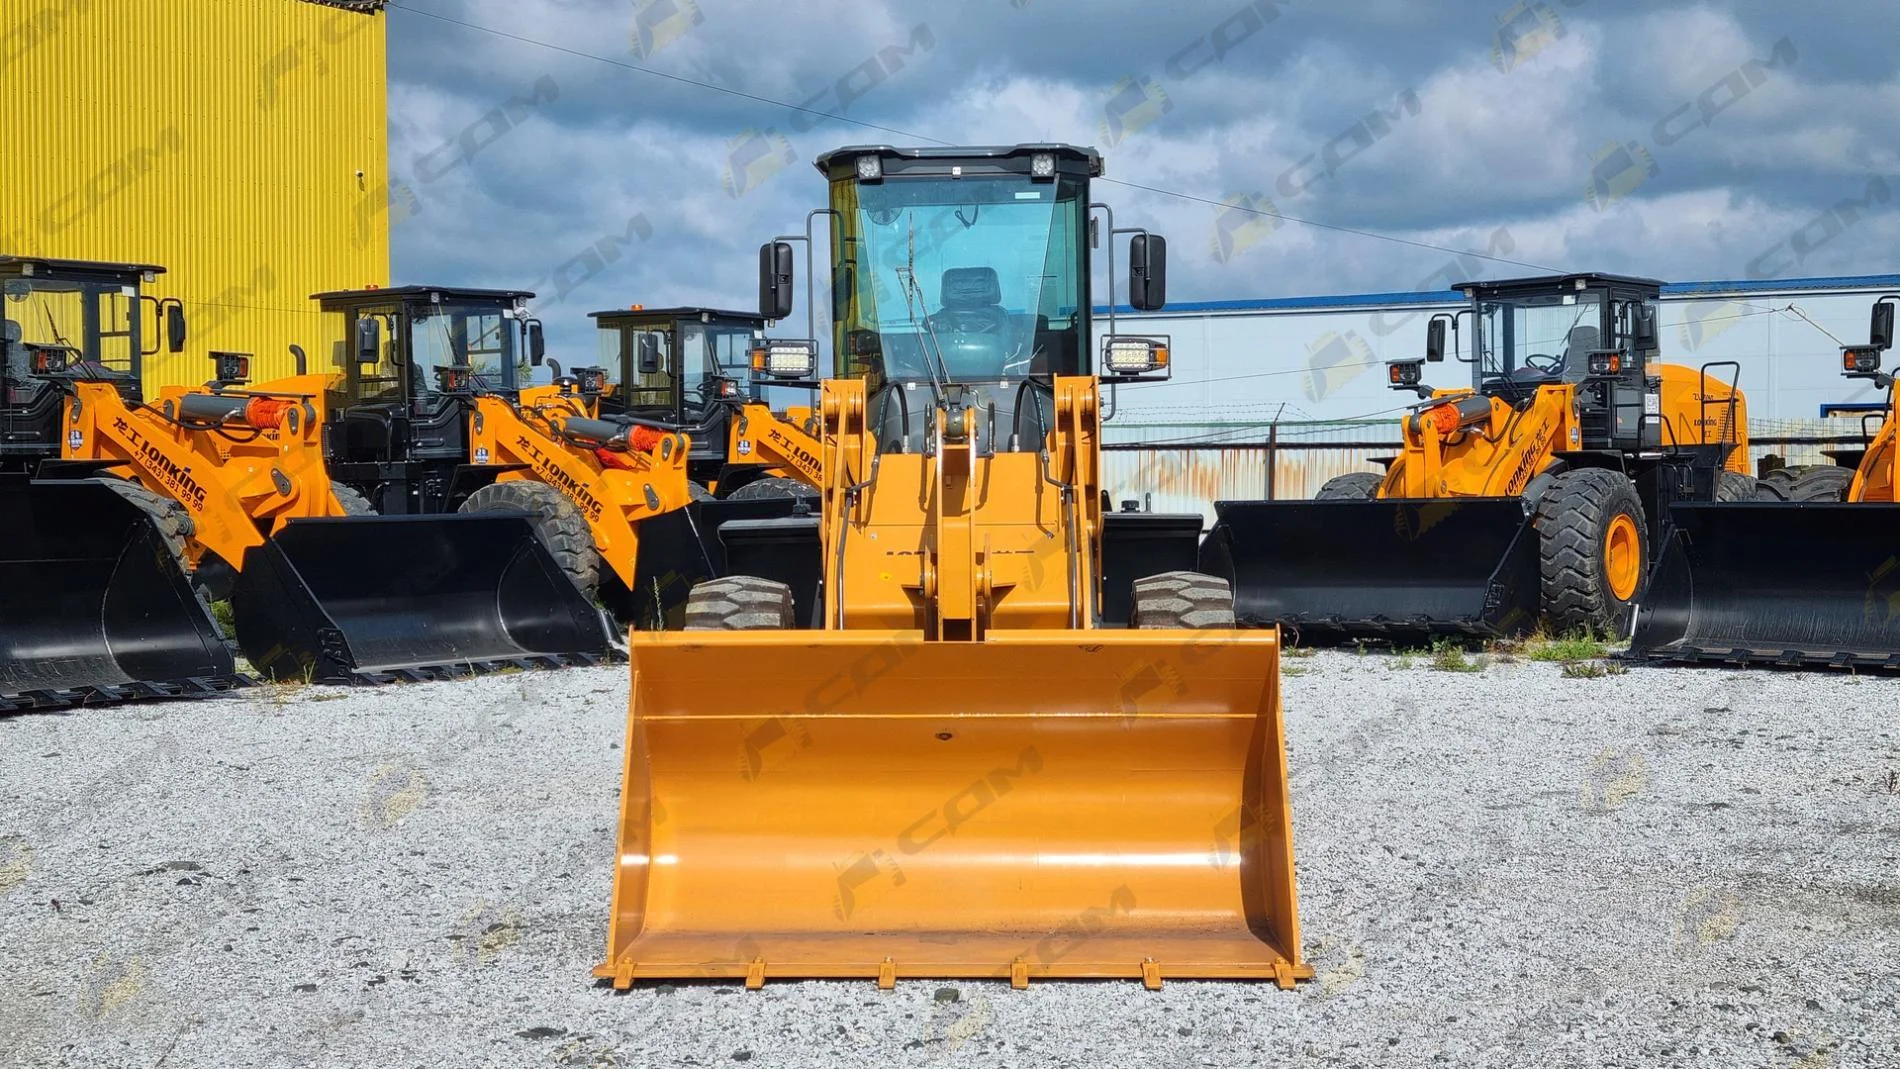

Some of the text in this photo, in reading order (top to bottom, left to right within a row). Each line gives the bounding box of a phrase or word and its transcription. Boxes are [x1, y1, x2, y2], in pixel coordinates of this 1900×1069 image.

[144, 457, 165, 481] (343)
[164, 476, 181, 493] 381
[181, 489, 193, 503] 99
[191, 499, 204, 512] 99
